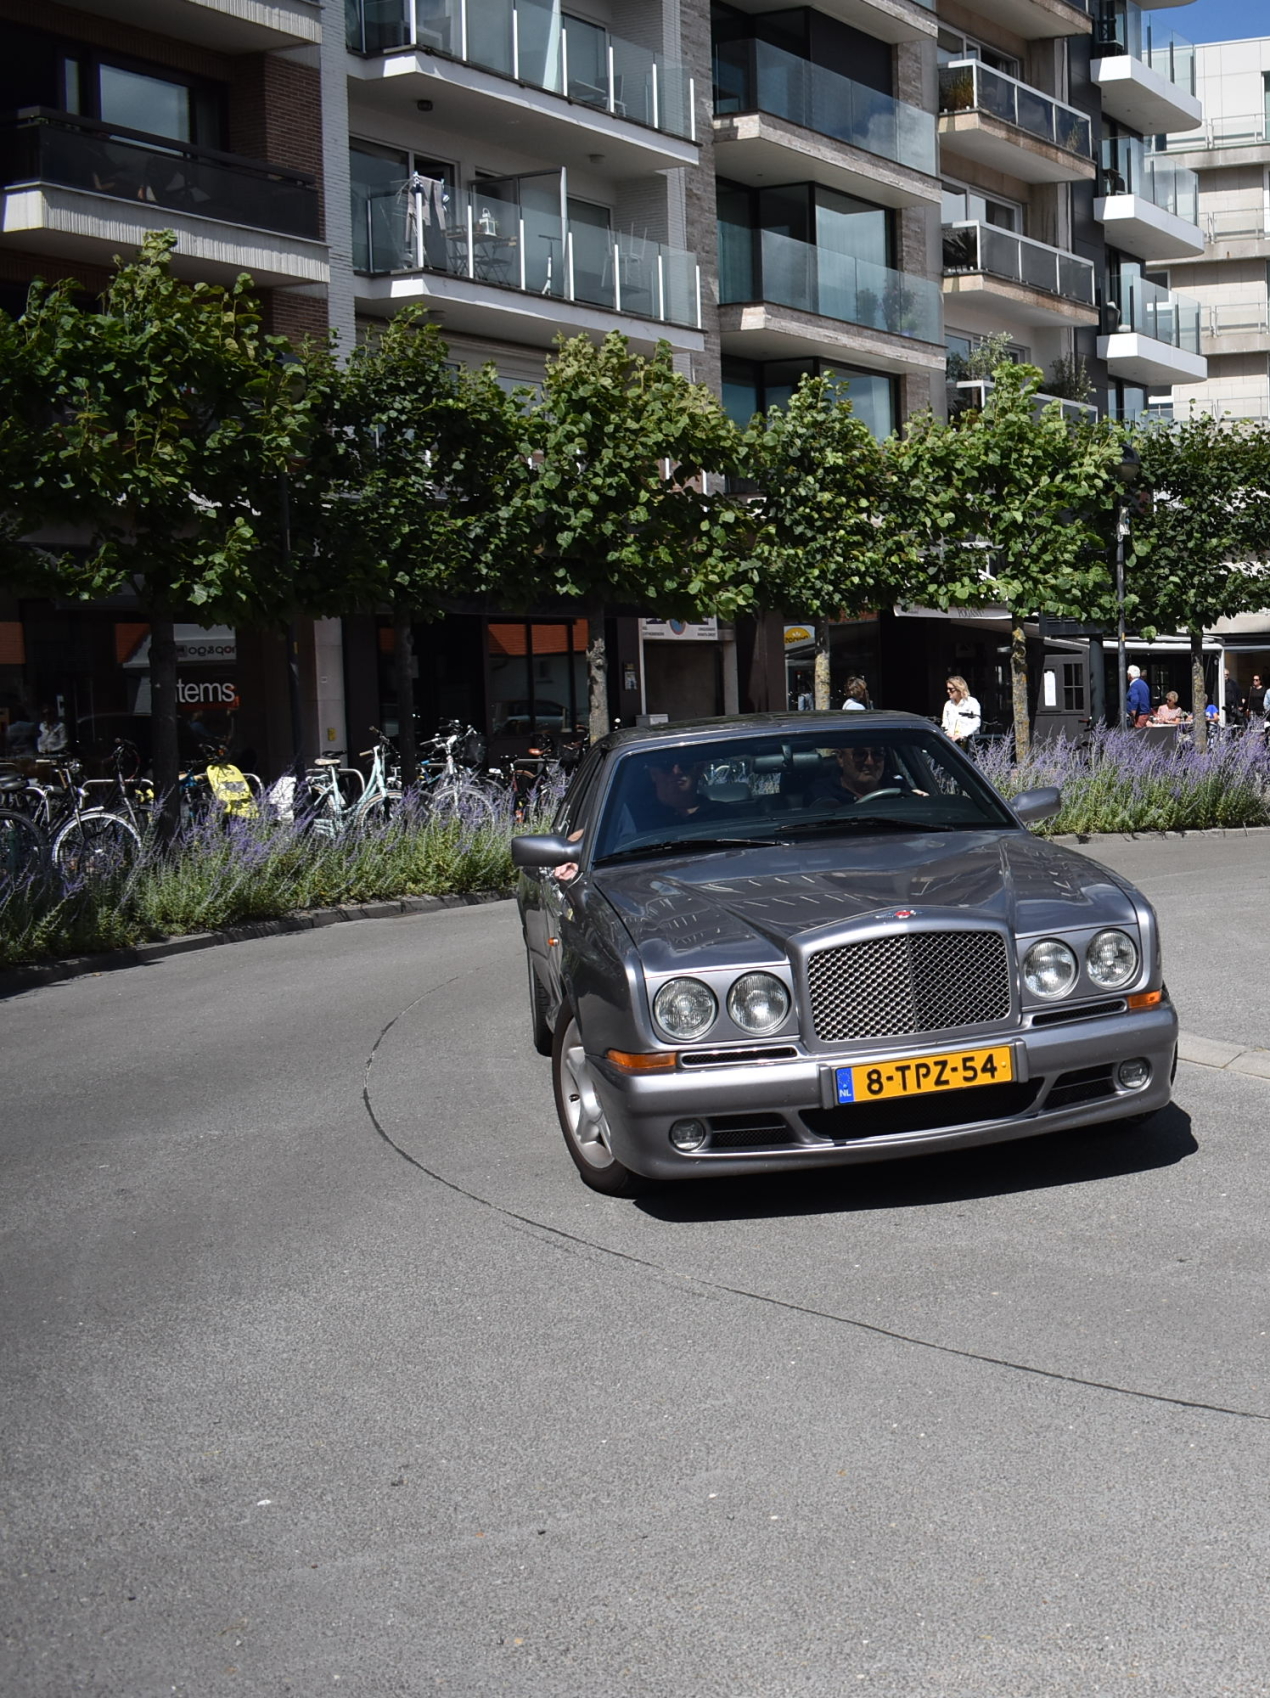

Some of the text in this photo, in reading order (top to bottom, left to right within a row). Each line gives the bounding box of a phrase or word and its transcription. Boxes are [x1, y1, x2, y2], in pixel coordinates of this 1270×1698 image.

[175, 679, 236, 703] tems
[866, 1053, 998, 1095] 8-TPZ-54
[839, 1088, 852, 1097] NL
